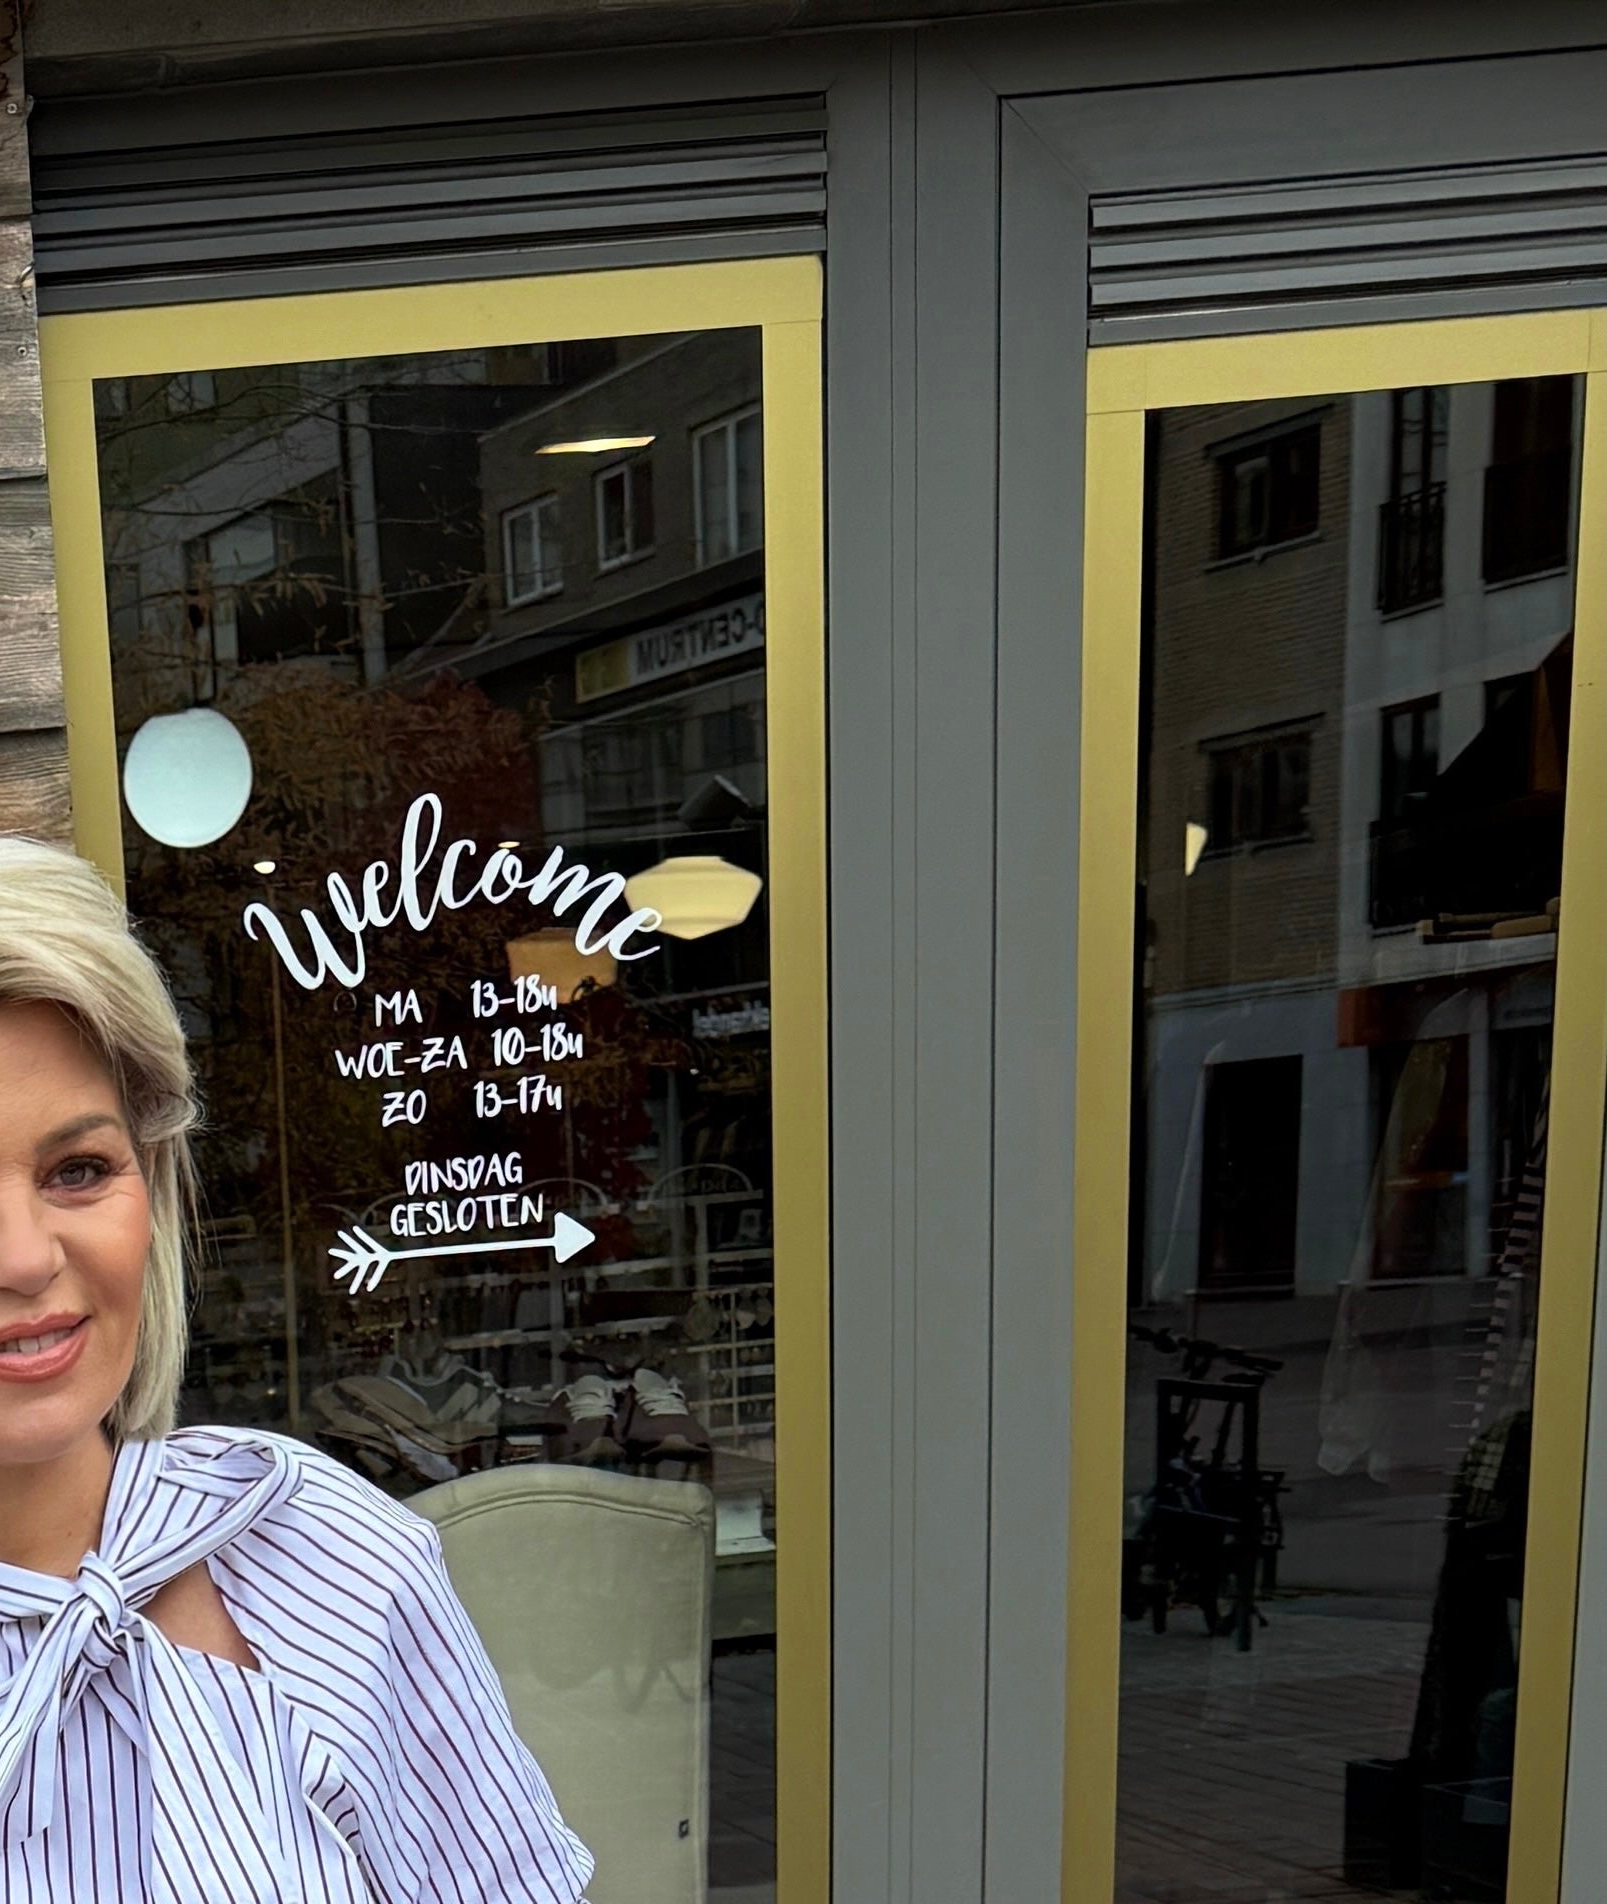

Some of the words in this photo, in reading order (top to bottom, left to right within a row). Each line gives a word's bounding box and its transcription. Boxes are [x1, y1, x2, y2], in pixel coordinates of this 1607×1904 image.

[243, 793, 663, 990] Welcome
[374, 990, 423, 1028] MA
[470, 975, 558, 1018] 13-18u
[335, 1036, 467, 1079] WOE-ZA
[493, 1022, 583, 1067] 10-18u
[382, 1089, 427, 1127] ZO
[474, 1075, 562, 1118] 13-17u
[405, 1152, 523, 1195] DINSDAG
[390, 1194, 544, 1238] GESLOTEN
